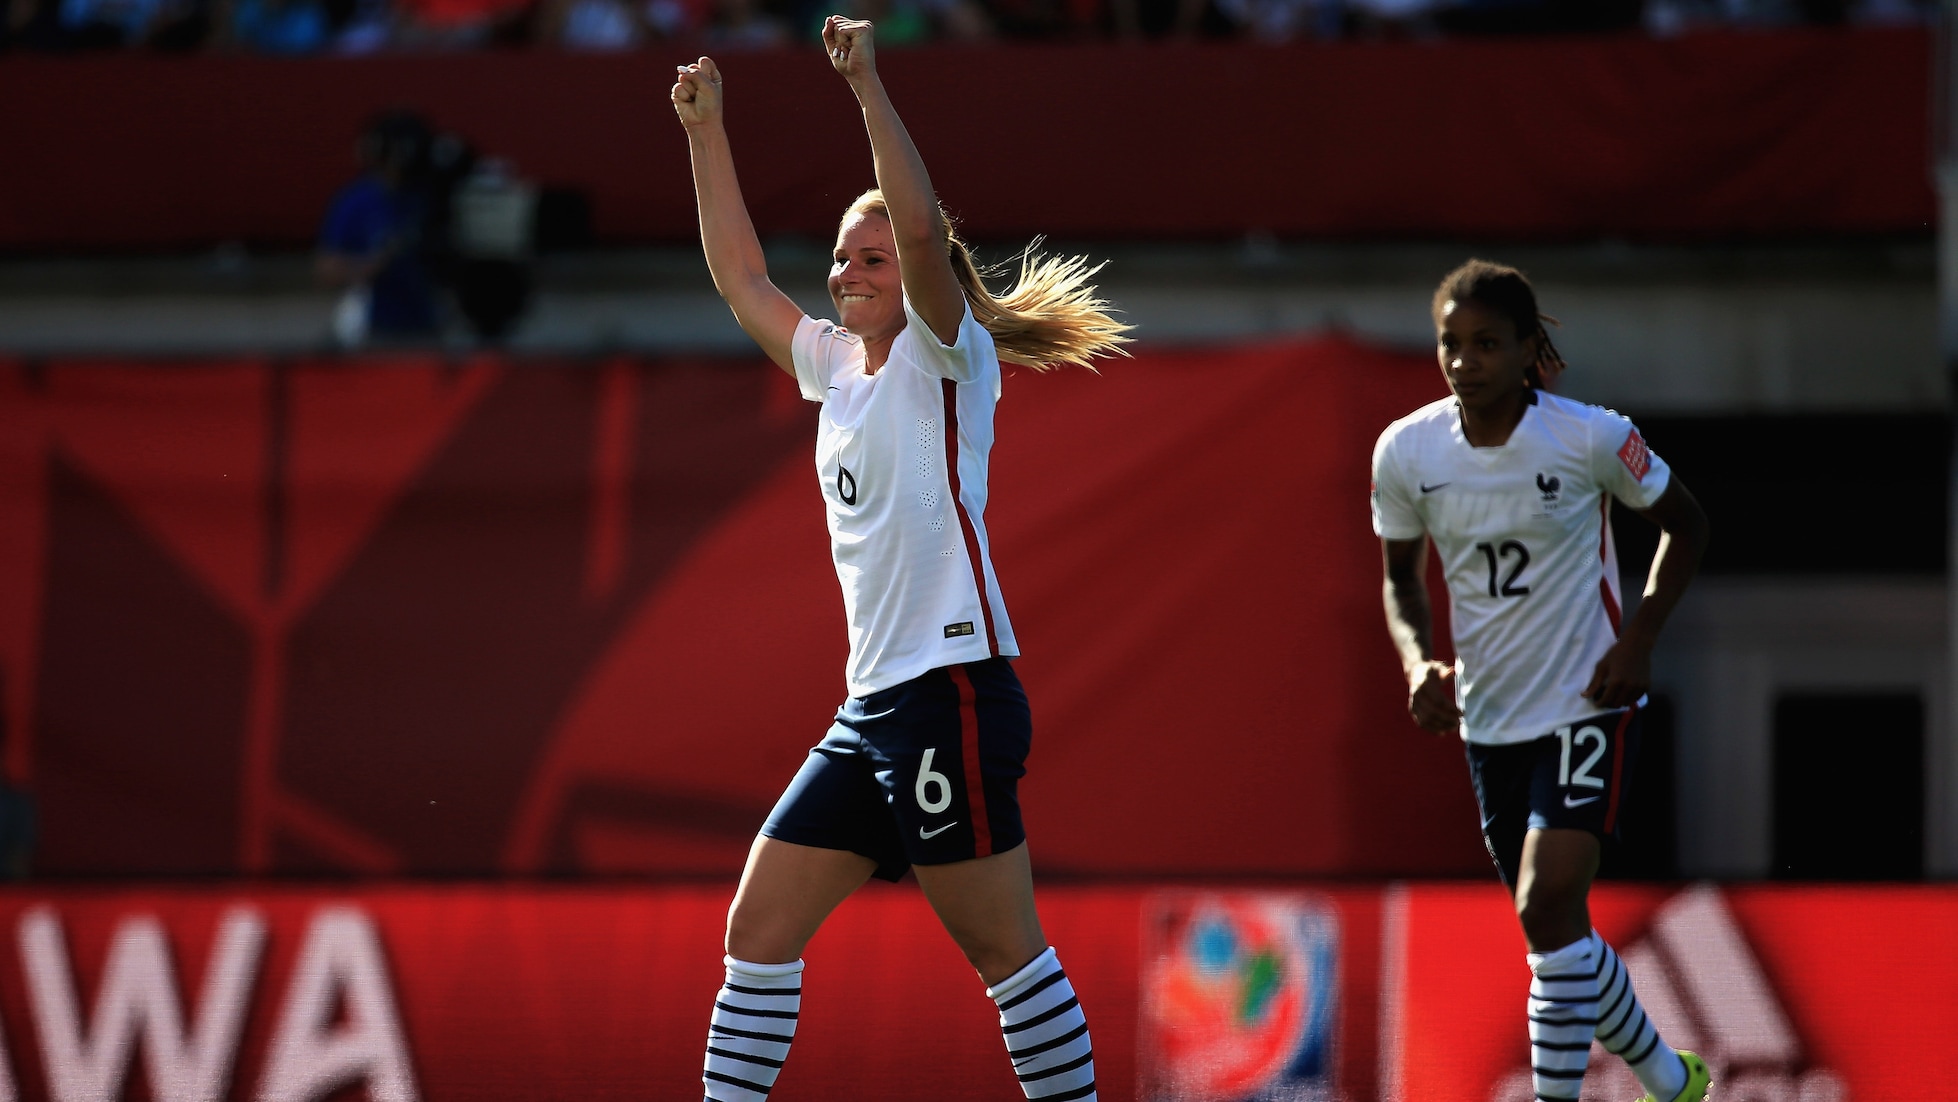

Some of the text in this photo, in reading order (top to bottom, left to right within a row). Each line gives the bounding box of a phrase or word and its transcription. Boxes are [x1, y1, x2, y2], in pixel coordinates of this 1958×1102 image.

[837, 447, 857, 506] 6
[1477, 540, 1531, 597] 12
[916, 748, 952, 814] 6
[1556, 725, 1607, 789] 12
